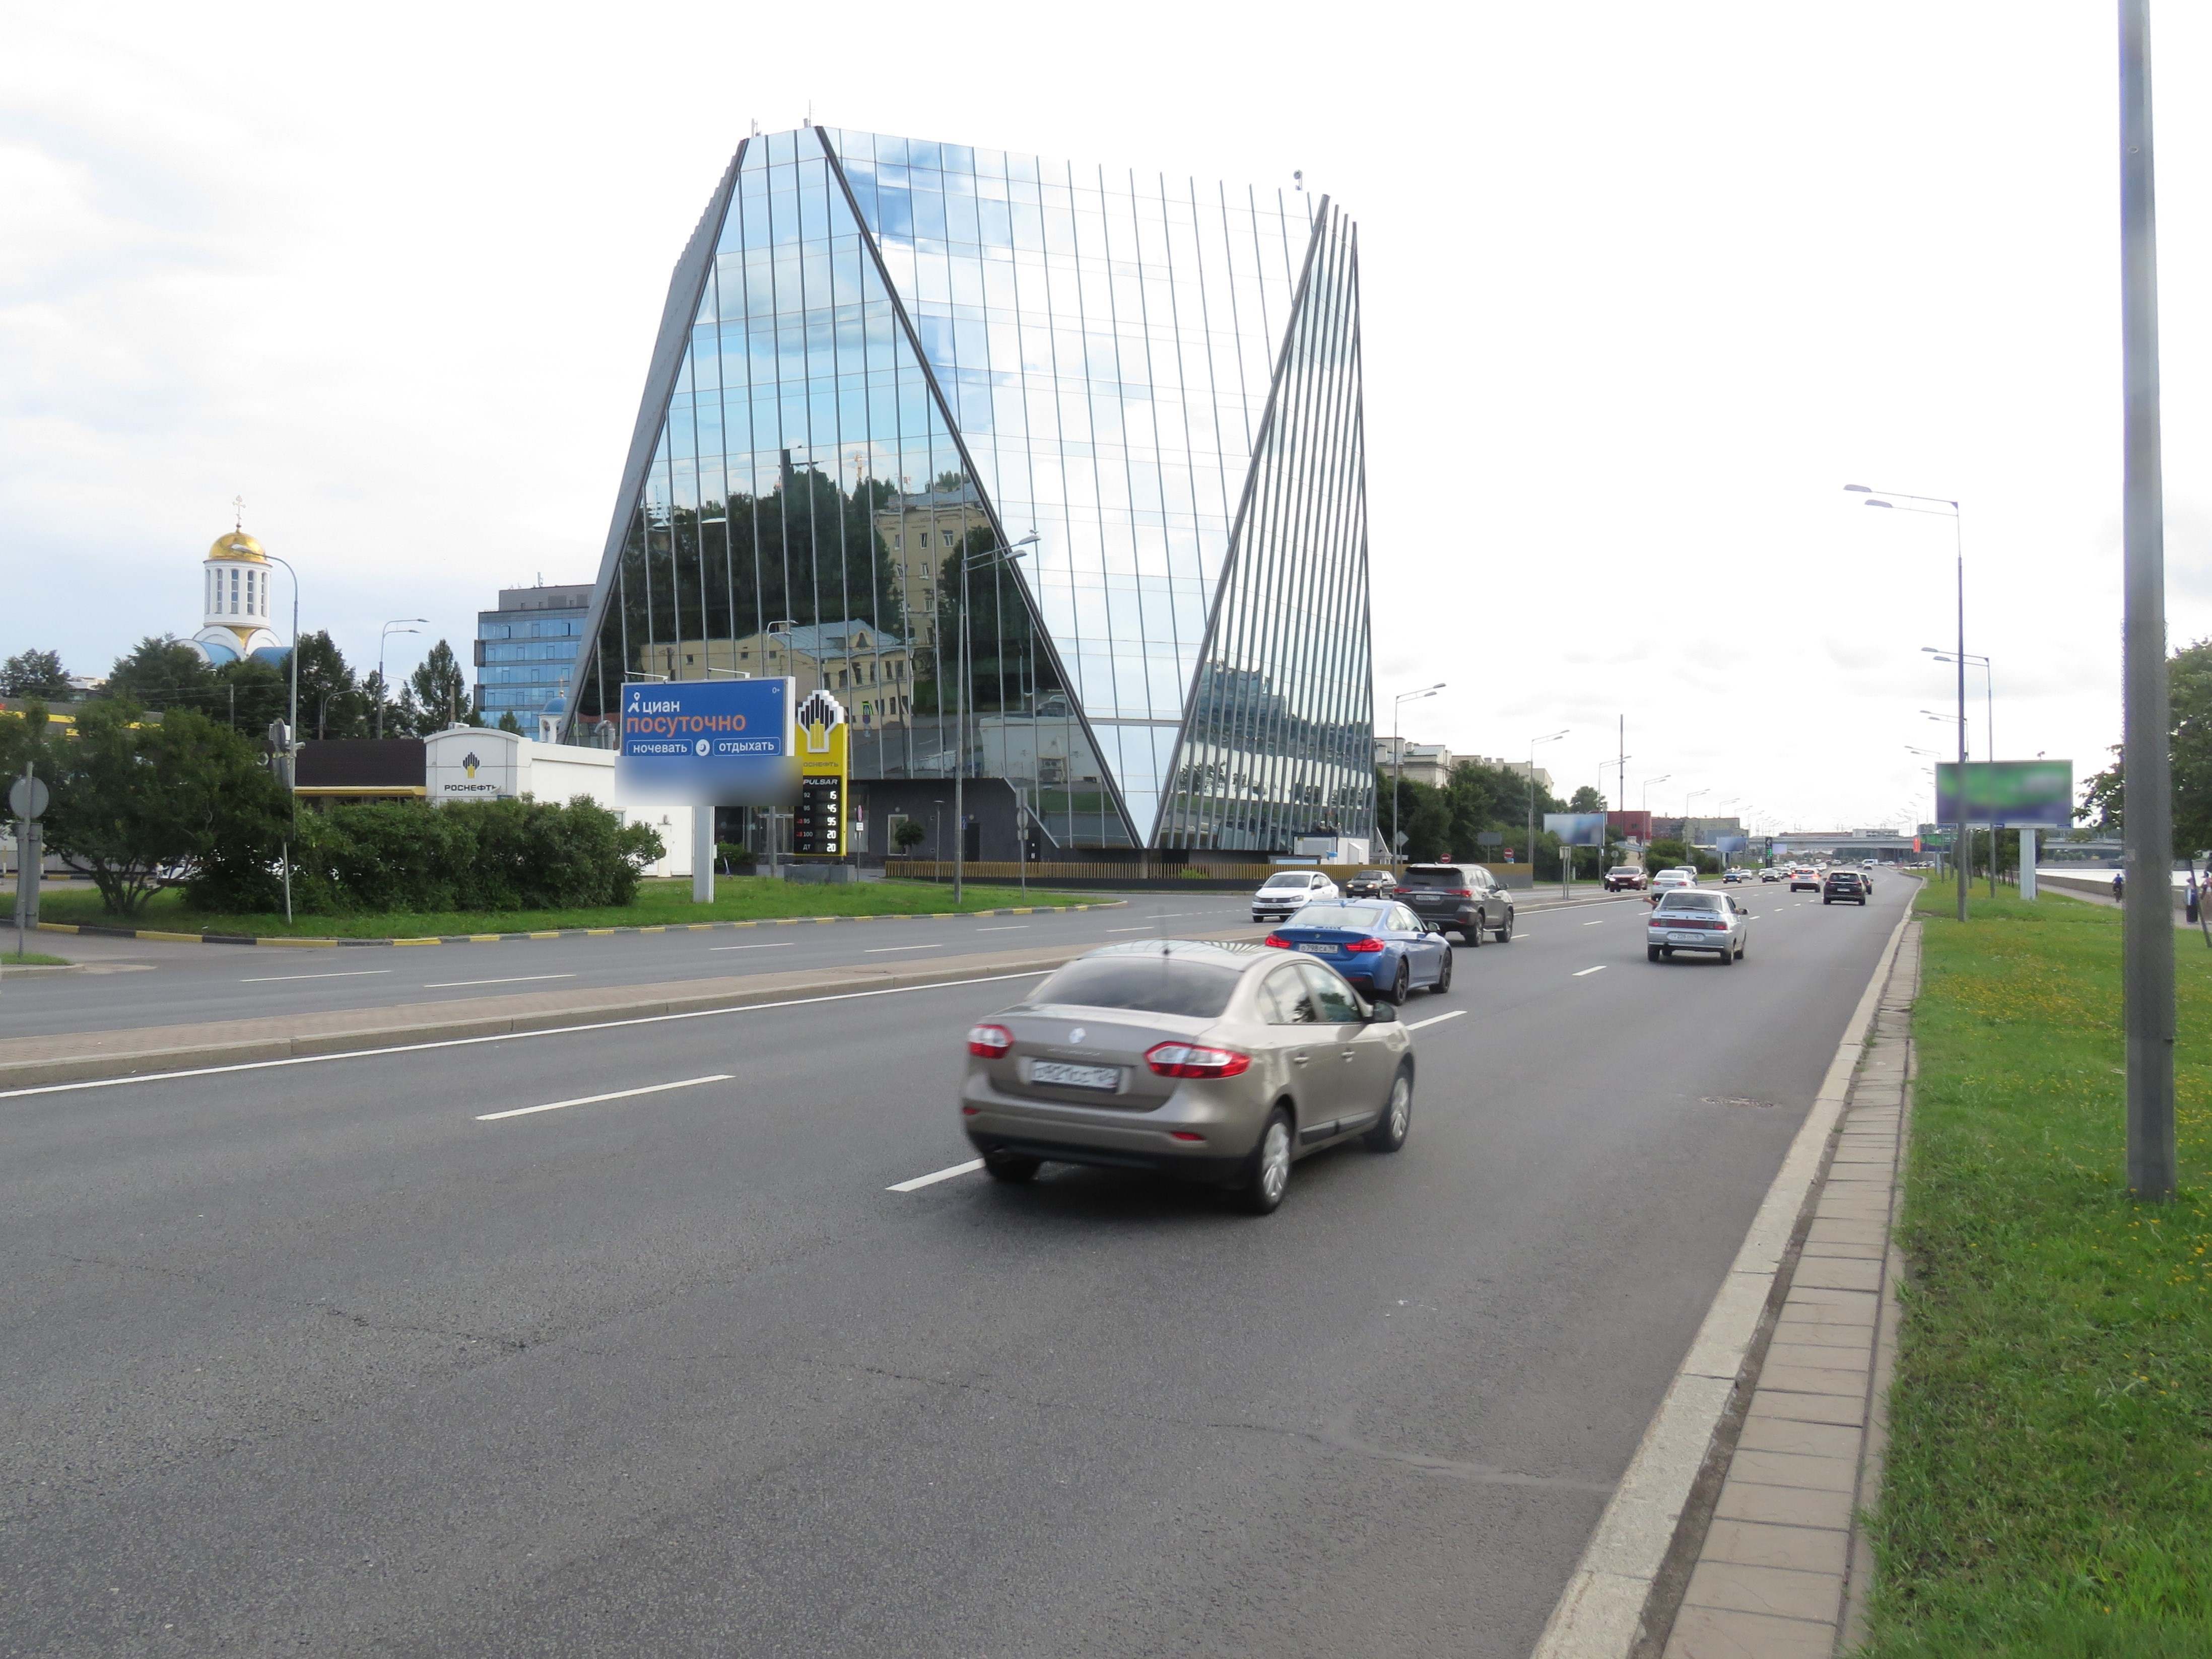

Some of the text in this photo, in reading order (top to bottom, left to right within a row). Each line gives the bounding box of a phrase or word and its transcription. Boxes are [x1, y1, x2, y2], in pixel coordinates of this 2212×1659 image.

[643, 701, 680, 714] циан
[627, 715, 747, 738] посуточно
[633, 743, 688, 753] ночевать
[719, 741, 774, 753] отдыхать
